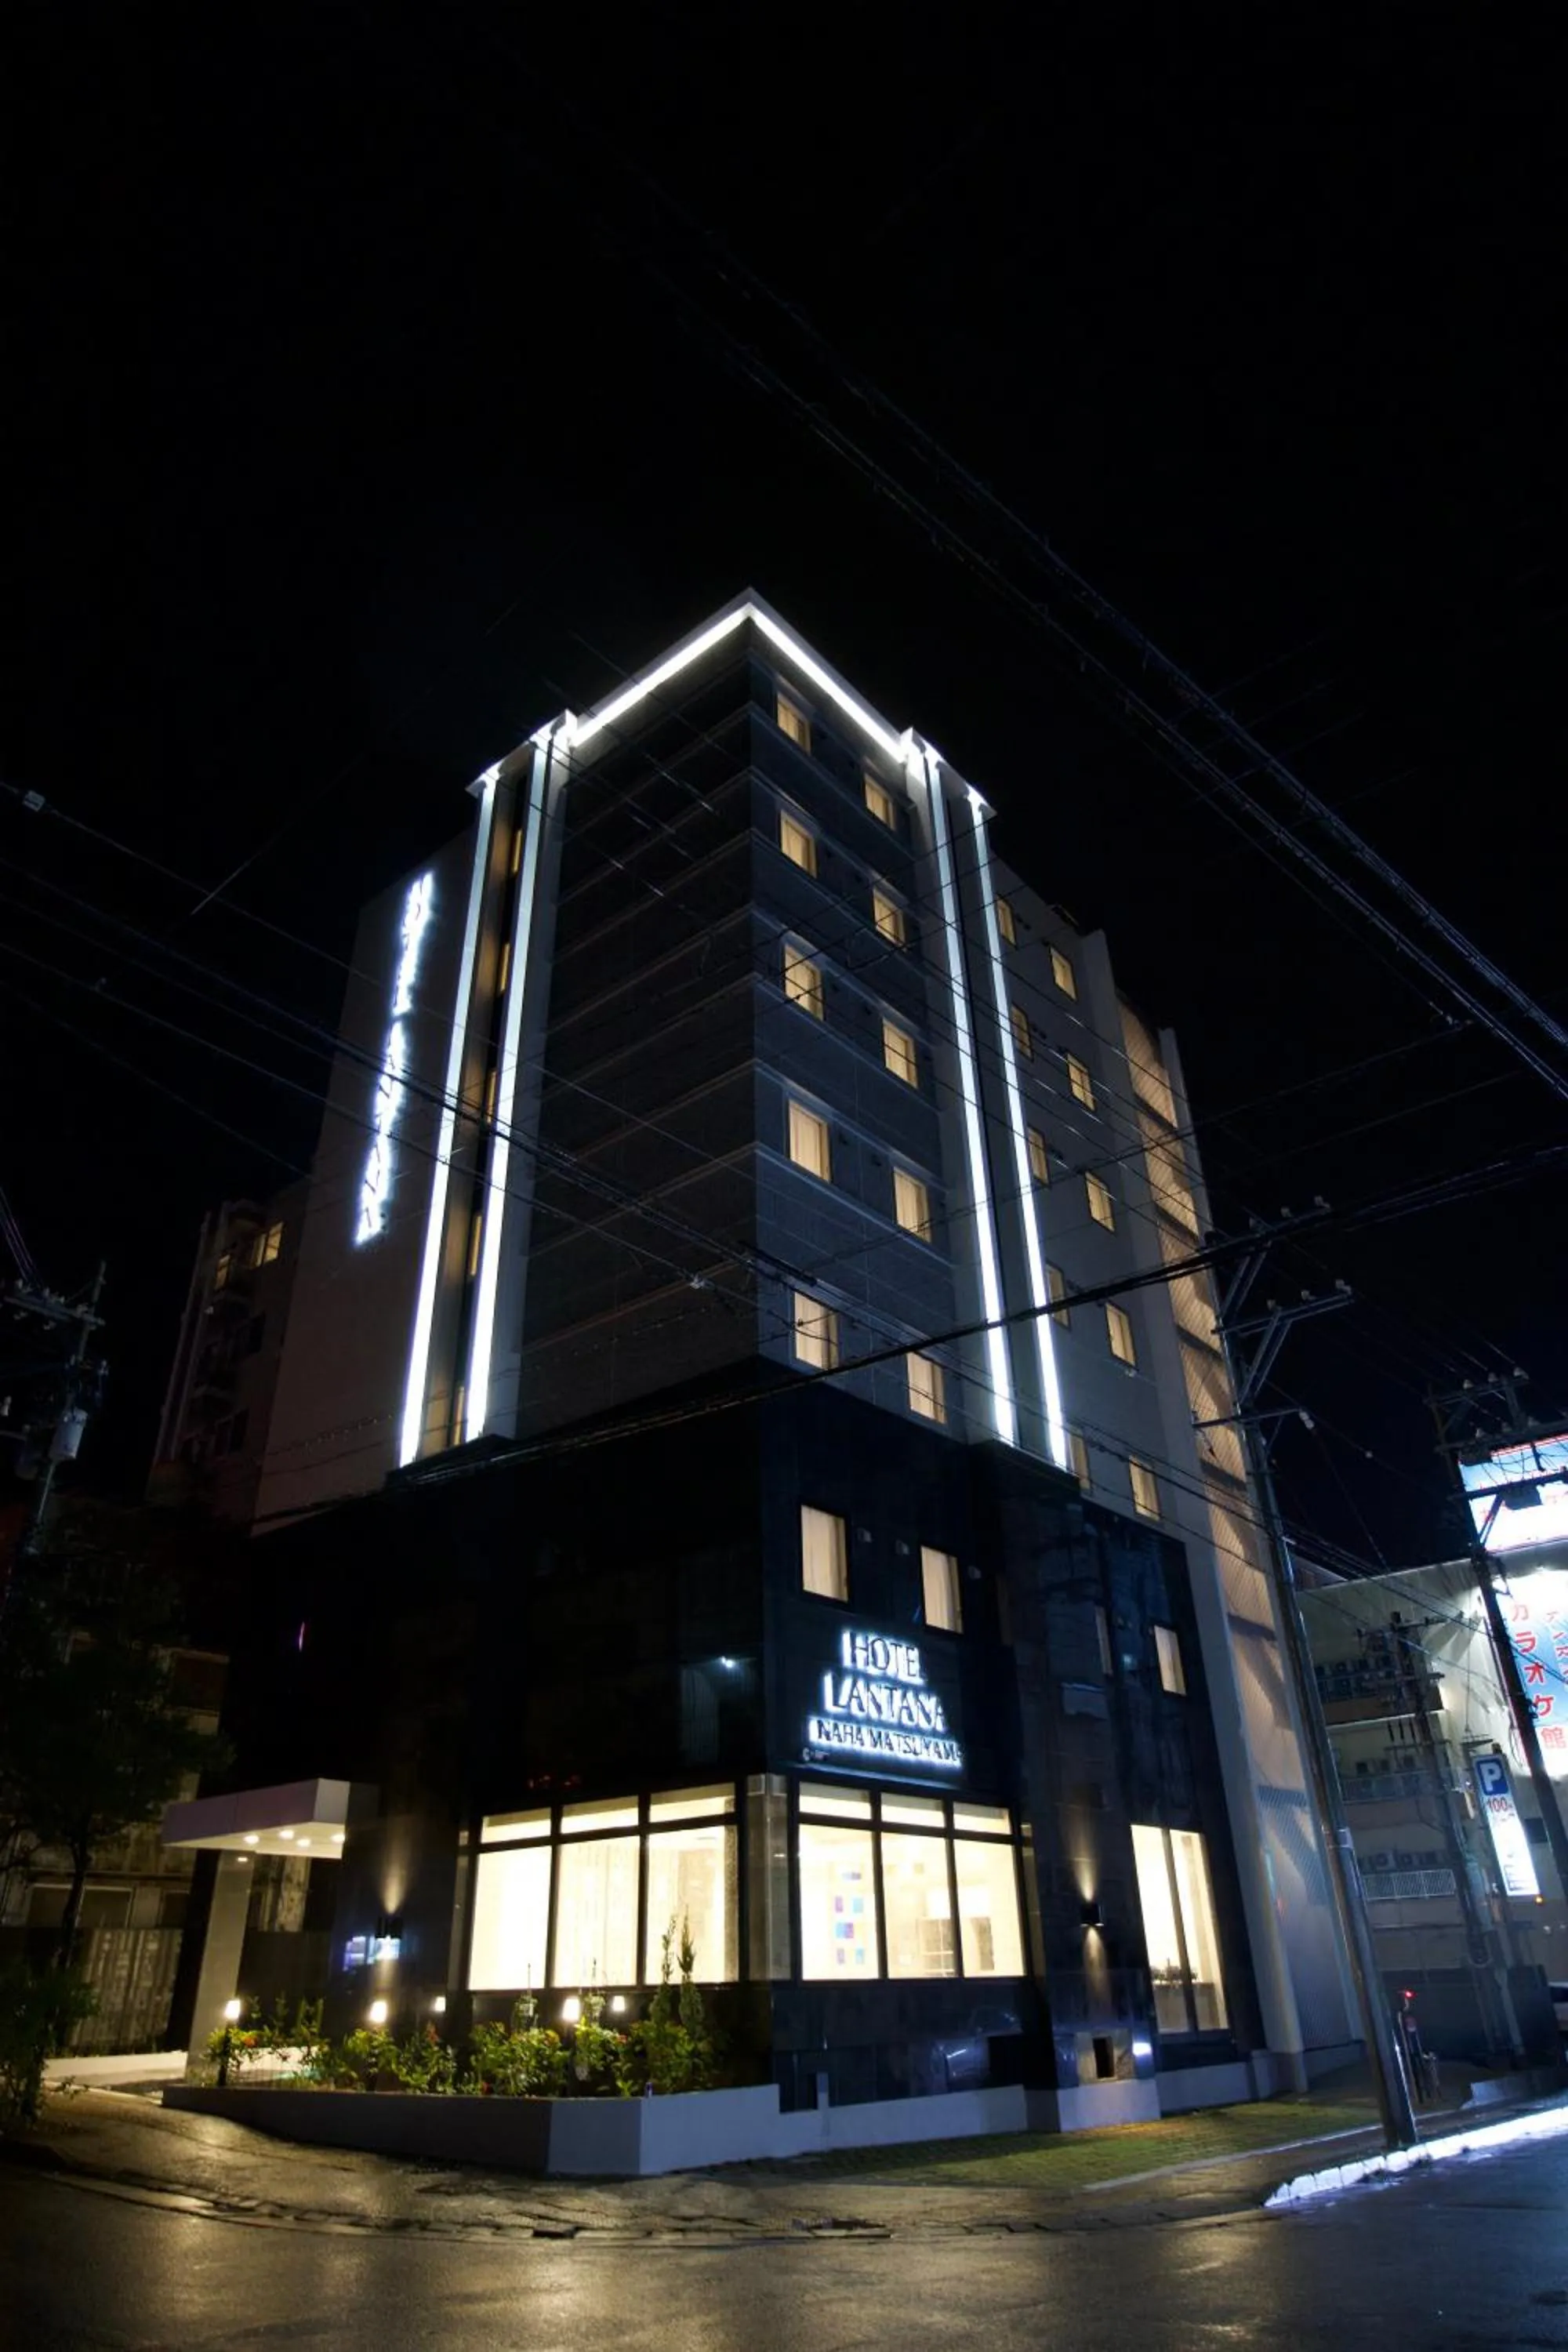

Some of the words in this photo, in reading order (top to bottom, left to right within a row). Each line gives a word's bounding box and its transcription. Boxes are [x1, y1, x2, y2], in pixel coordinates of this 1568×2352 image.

[842, 1631, 927, 1684] HOTEL
[823, 1674, 946, 1731] LANTANA
[811, 1719, 864, 1751] NAHA
[867, 1727, 964, 1766] MATSUYAMA
[1479, 1762, 1501, 1791] P
